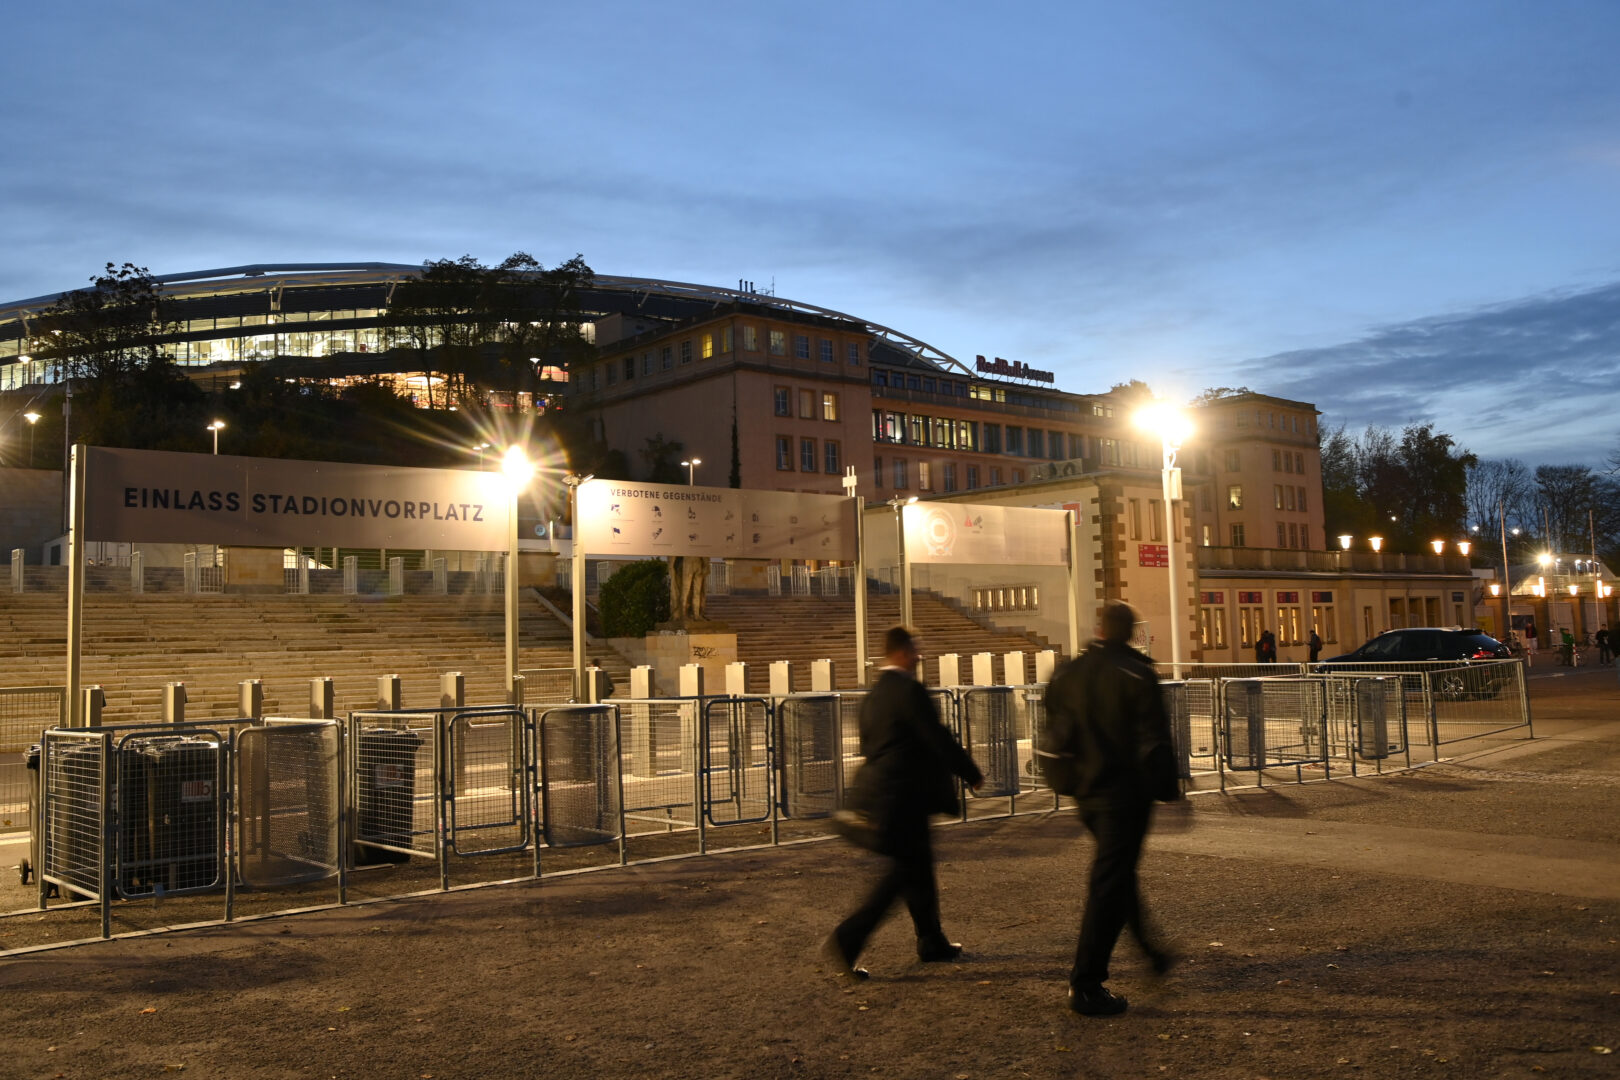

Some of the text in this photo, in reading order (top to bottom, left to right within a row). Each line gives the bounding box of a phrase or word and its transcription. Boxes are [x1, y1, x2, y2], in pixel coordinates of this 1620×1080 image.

[1021, 363, 1054, 383] Arena
[124, 487, 484, 522] EINLASS STADIONVORPLATZ
[610, 488, 723, 503] VERBOTENE GEGENSTÄNDE
